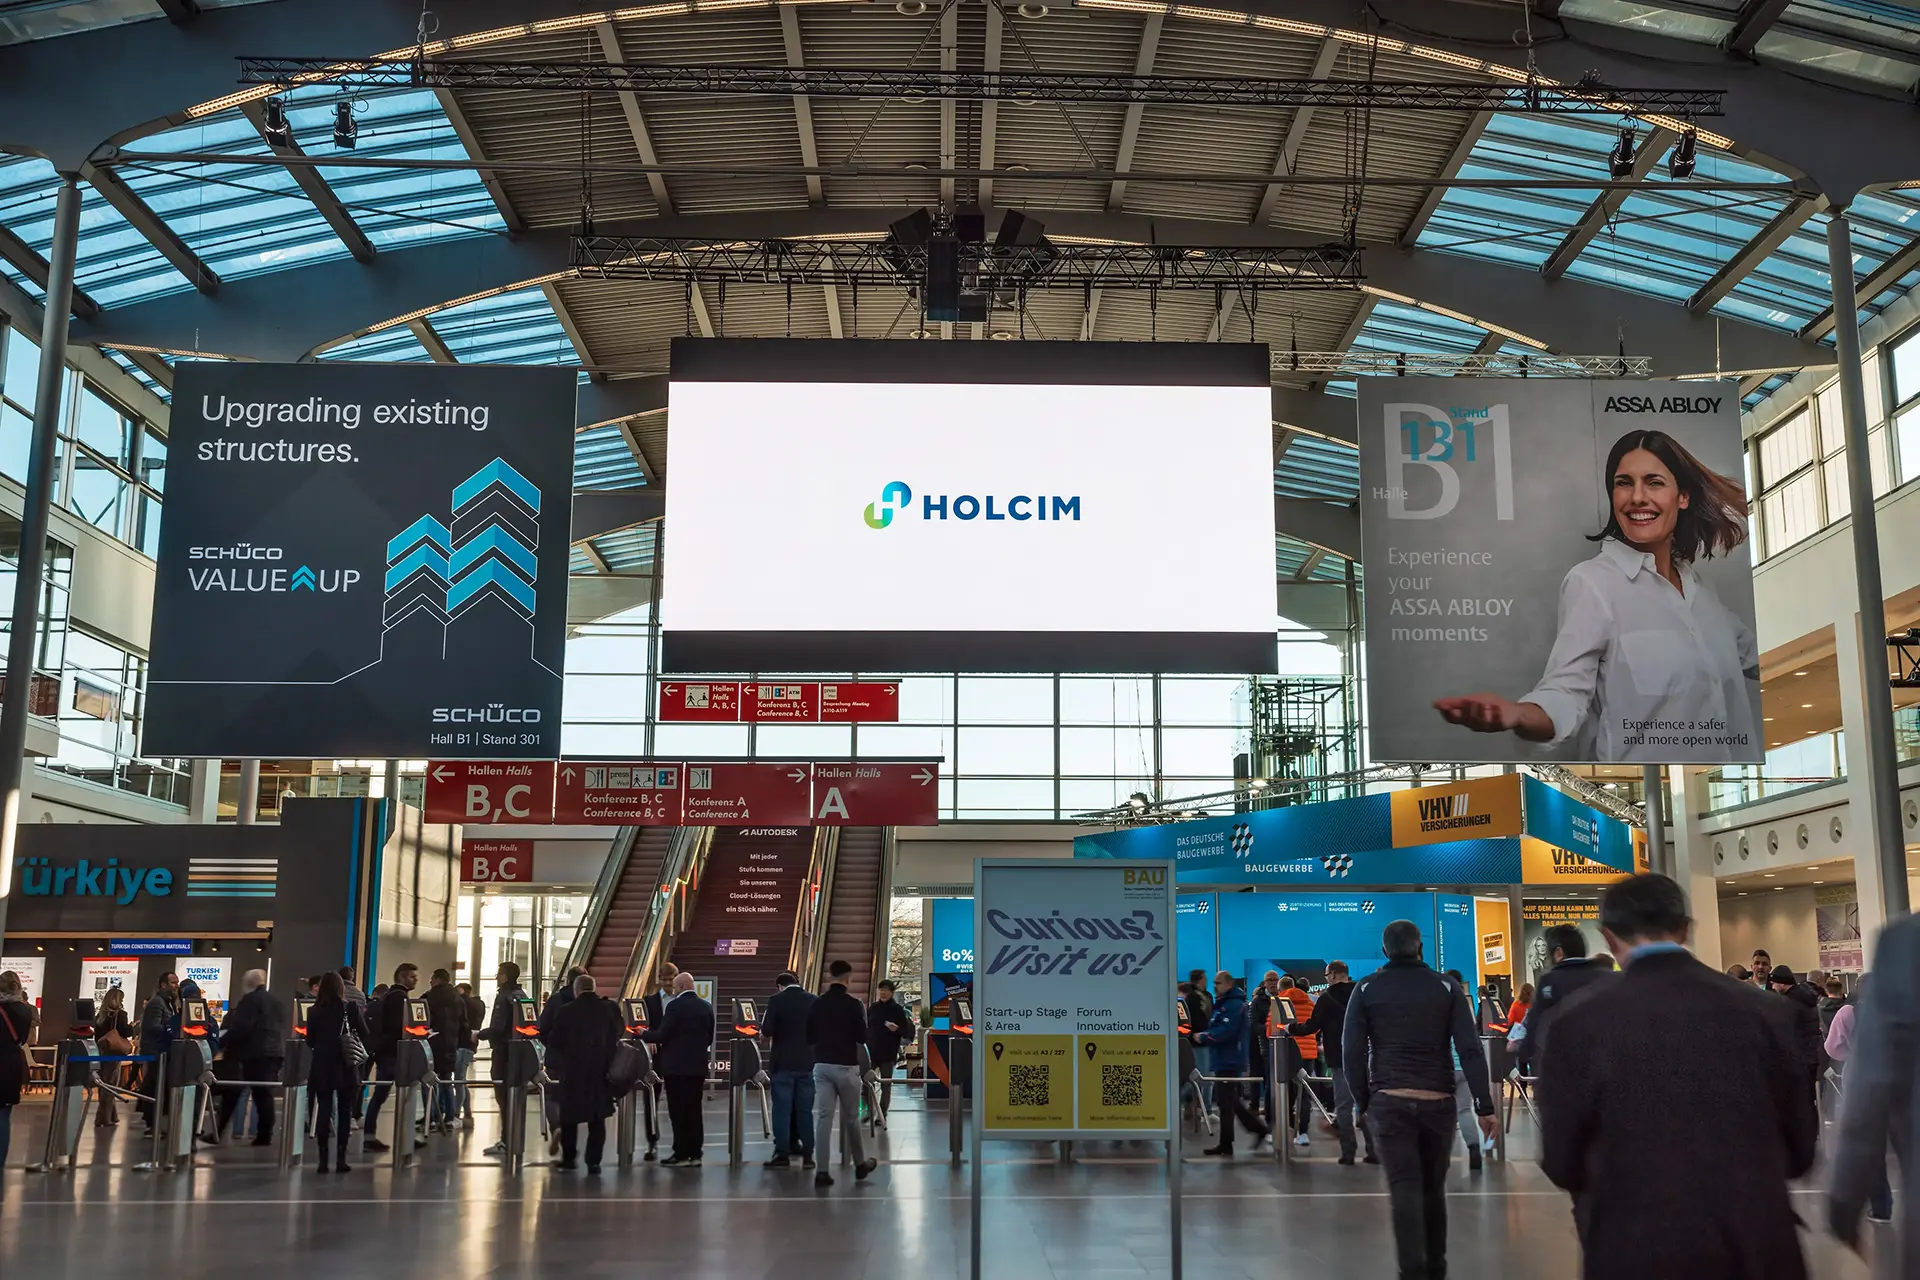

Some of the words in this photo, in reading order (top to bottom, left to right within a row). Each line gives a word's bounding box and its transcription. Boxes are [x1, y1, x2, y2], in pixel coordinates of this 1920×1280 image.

[1450, 406, 1489, 419] Stand
[1604, 396, 1656, 413] ASSA
[1659, 396, 1723, 414] ABLOY
[201, 395, 361, 428] Upgrading
[373, 399, 490, 431] existing
[1401, 421, 1477, 462] 131
[197, 438, 360, 463] structures.
[1383, 402, 1515, 521] B1
[1373, 487, 1408, 500] Halle
[923, 494, 1081, 521] HOLCIM
[188, 542, 283, 560] SCHÜCO
[1388, 548, 1492, 567] Experience
[188, 568, 287, 592] VALUE
[319, 570, 361, 593] UP
[1388, 575, 1432, 595] your
[1390, 598, 1442, 616] ASSA
[1447, 598, 1513, 617] ABLOY
[1391, 626, 1488, 642] moments
[712, 685, 734, 693] Hallen
[432, 703, 541, 723] SCHÜCO
[757, 701, 791, 709] Konferenz
[792, 702, 801, 710] B,
[794, 710, 802, 719] B,
[1622, 719, 1685, 733] Experience
[1688, 722, 1695, 731] a
[1697, 719, 1726, 731] safer
[430, 733, 453, 745] Hall
[456, 733, 471, 745] B1
[482, 733, 516, 745] Stand
[520, 733, 541, 745] 301
[1623, 734, 1646, 746] and
[1648, 737, 1679, 746] more
[1683, 737, 1712, 749] open
[1714, 734, 1749, 746] world
[468, 765, 502, 776] Hallen
[506, 766, 533, 776] Halls
[610, 770, 630, 779] press
[818, 768, 852, 778] Hallen
[855, 768, 881, 778] Halls
[465, 784, 531, 823] B,C
[584, 793, 638, 804] Konferenz
[641, 794, 652, 806] B,
[655, 794, 663, 804] C
[688, 797, 734, 807] Konferenz
[737, 797, 746, 807] A
[818, 787, 850, 820] A
[583, 808, 642, 818] Conference
[643, 808, 655, 820] B,
[657, 808, 666, 818] C
[688, 810, 738, 819] Conference
[741, 809, 749, 819] A
[1418, 796, 1454, 821] VHV
[1420, 814, 1491, 833] VERSICHERUNGEN
[1176, 836, 1190, 847] DAS
[1190, 832, 1225, 845] DEUTSCHE
[474, 844, 498, 852] Hallen
[500, 844, 518, 852] Halls
[1177, 845, 1225, 860] BAUGEWERBE
[472, 857, 517, 882] B,C
[1245, 864, 1313, 873] BAUGEWERBE
[1124, 868, 1165, 885] BAU
[729, 892, 781, 900] Cloud-Lösungen
[986, 909, 1164, 940] Curious?
[942, 948, 974, 961] 80%
[985, 945, 1089, 976] Visit
[1087, 945, 1165, 976] us!
[186, 967, 220, 975] TURKISH
[985, 1006, 1033, 1018] Start-up
[1036, 1006, 1068, 1020] Stage
[1077, 1007, 1112, 1018] Forum
[984, 1022, 993, 1032] &
[995, 1022, 1021, 1032] Area
[1077, 1021, 1135, 1032] Innovation
[1137, 1021, 1161, 1032] Hub
